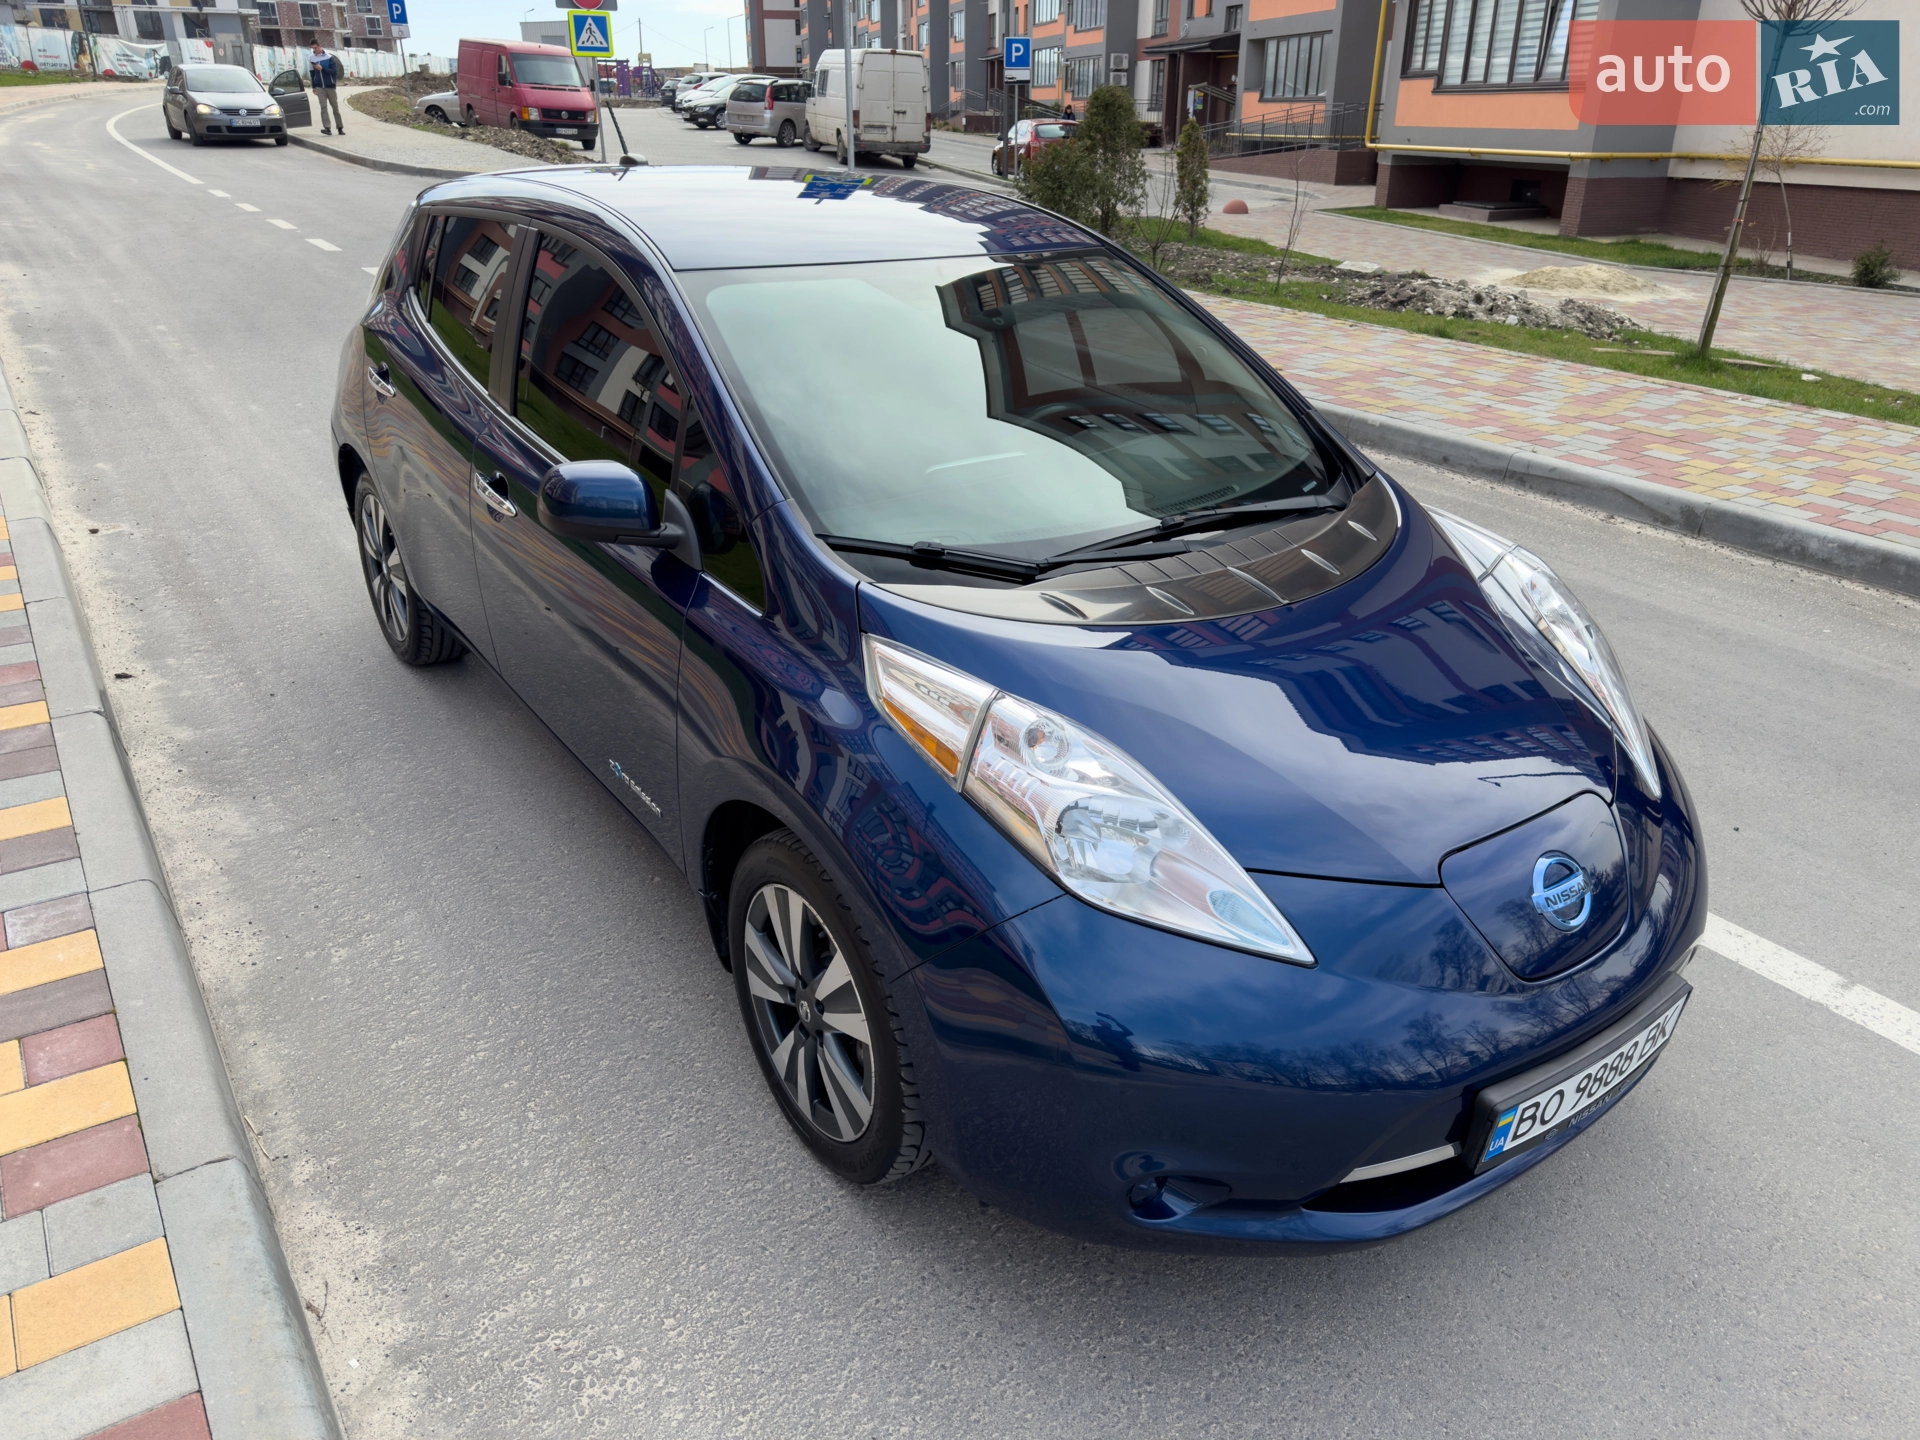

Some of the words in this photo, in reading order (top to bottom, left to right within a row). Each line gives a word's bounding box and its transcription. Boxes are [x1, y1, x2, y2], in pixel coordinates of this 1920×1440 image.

[392, 3, 402, 20] P
[1011, 43, 1024, 63] P
[1544, 879, 1590, 908] NISSAN
[1510, 1088, 1565, 1143] BO
[1567, 1040, 1639, 1113] 9888
[1637, 1003, 1681, 1063] BK
[1567, 1092, 1613, 1128] NISSAN
[1489, 1138, 1505, 1152] UA
